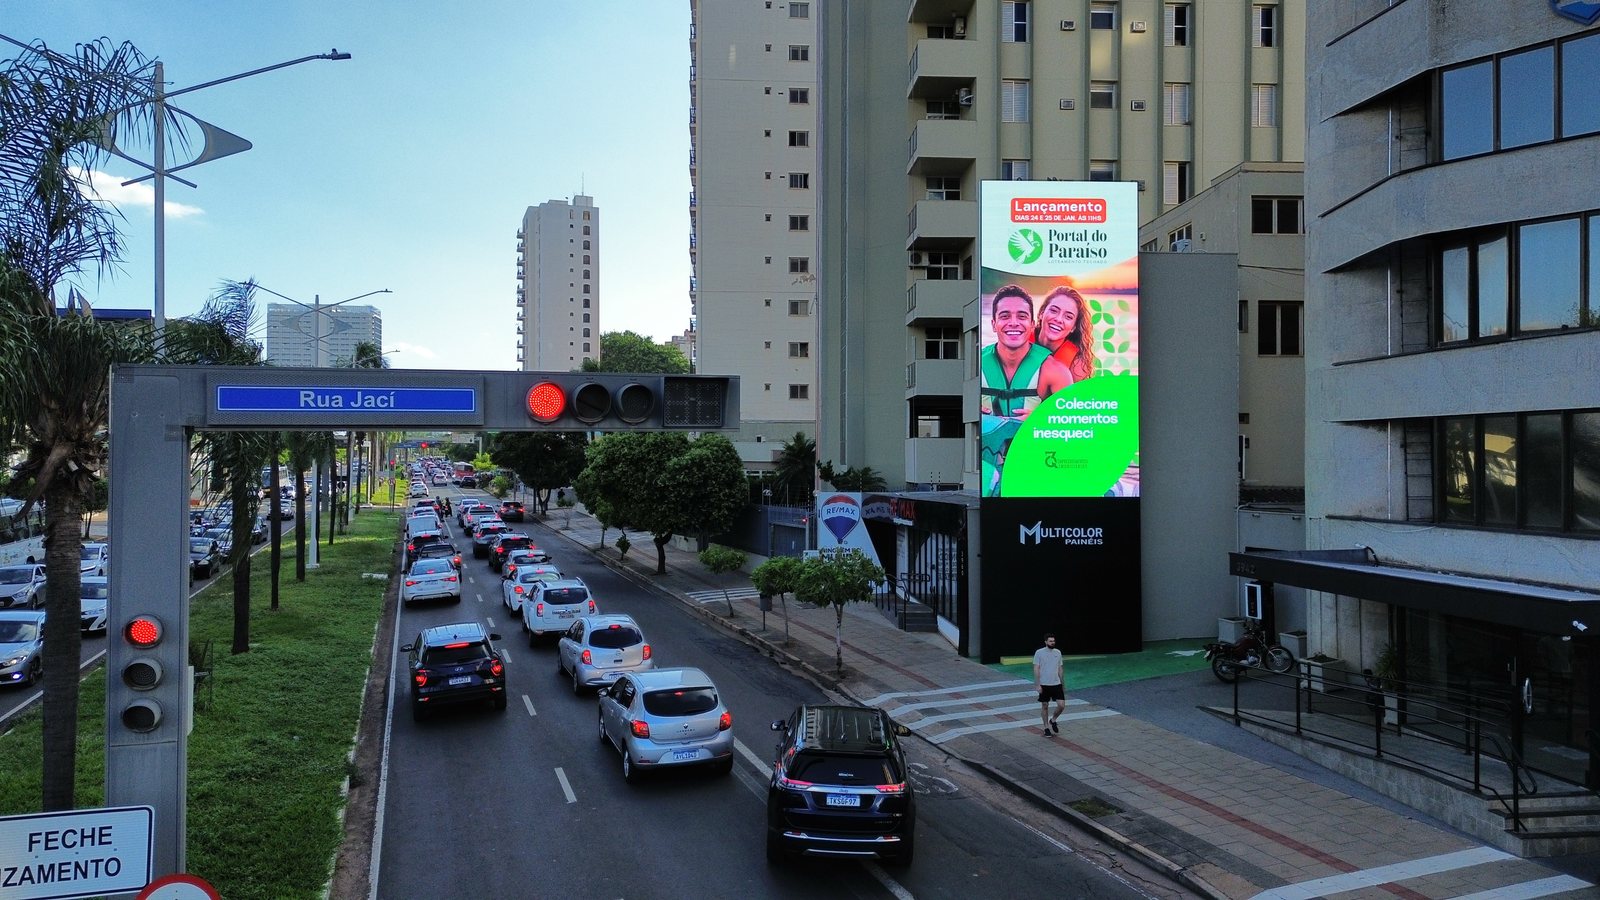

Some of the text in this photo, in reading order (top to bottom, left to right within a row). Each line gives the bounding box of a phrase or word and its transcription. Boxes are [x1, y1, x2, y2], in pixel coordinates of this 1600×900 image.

[1015, 201, 1103, 214] Lançamento
[1049, 229, 1108, 242] Portal do
[1049, 242, 1108, 258] Paraíso
[300, 391, 396, 408] Rua Jací
[1055, 397, 1118, 410] Colecione
[1048, 414, 1118, 424] momentos
[1033, 427, 1094, 441] inesqueci
[826, 506, 856, 515] RE/MAX
[1020, 520, 1103, 544] MULTICOLOR
[1065, 537, 1104, 545] PAINÉIS
[28, 825, 113, 853] FECHE
[0, 857, 122, 888] ZAMENTO
